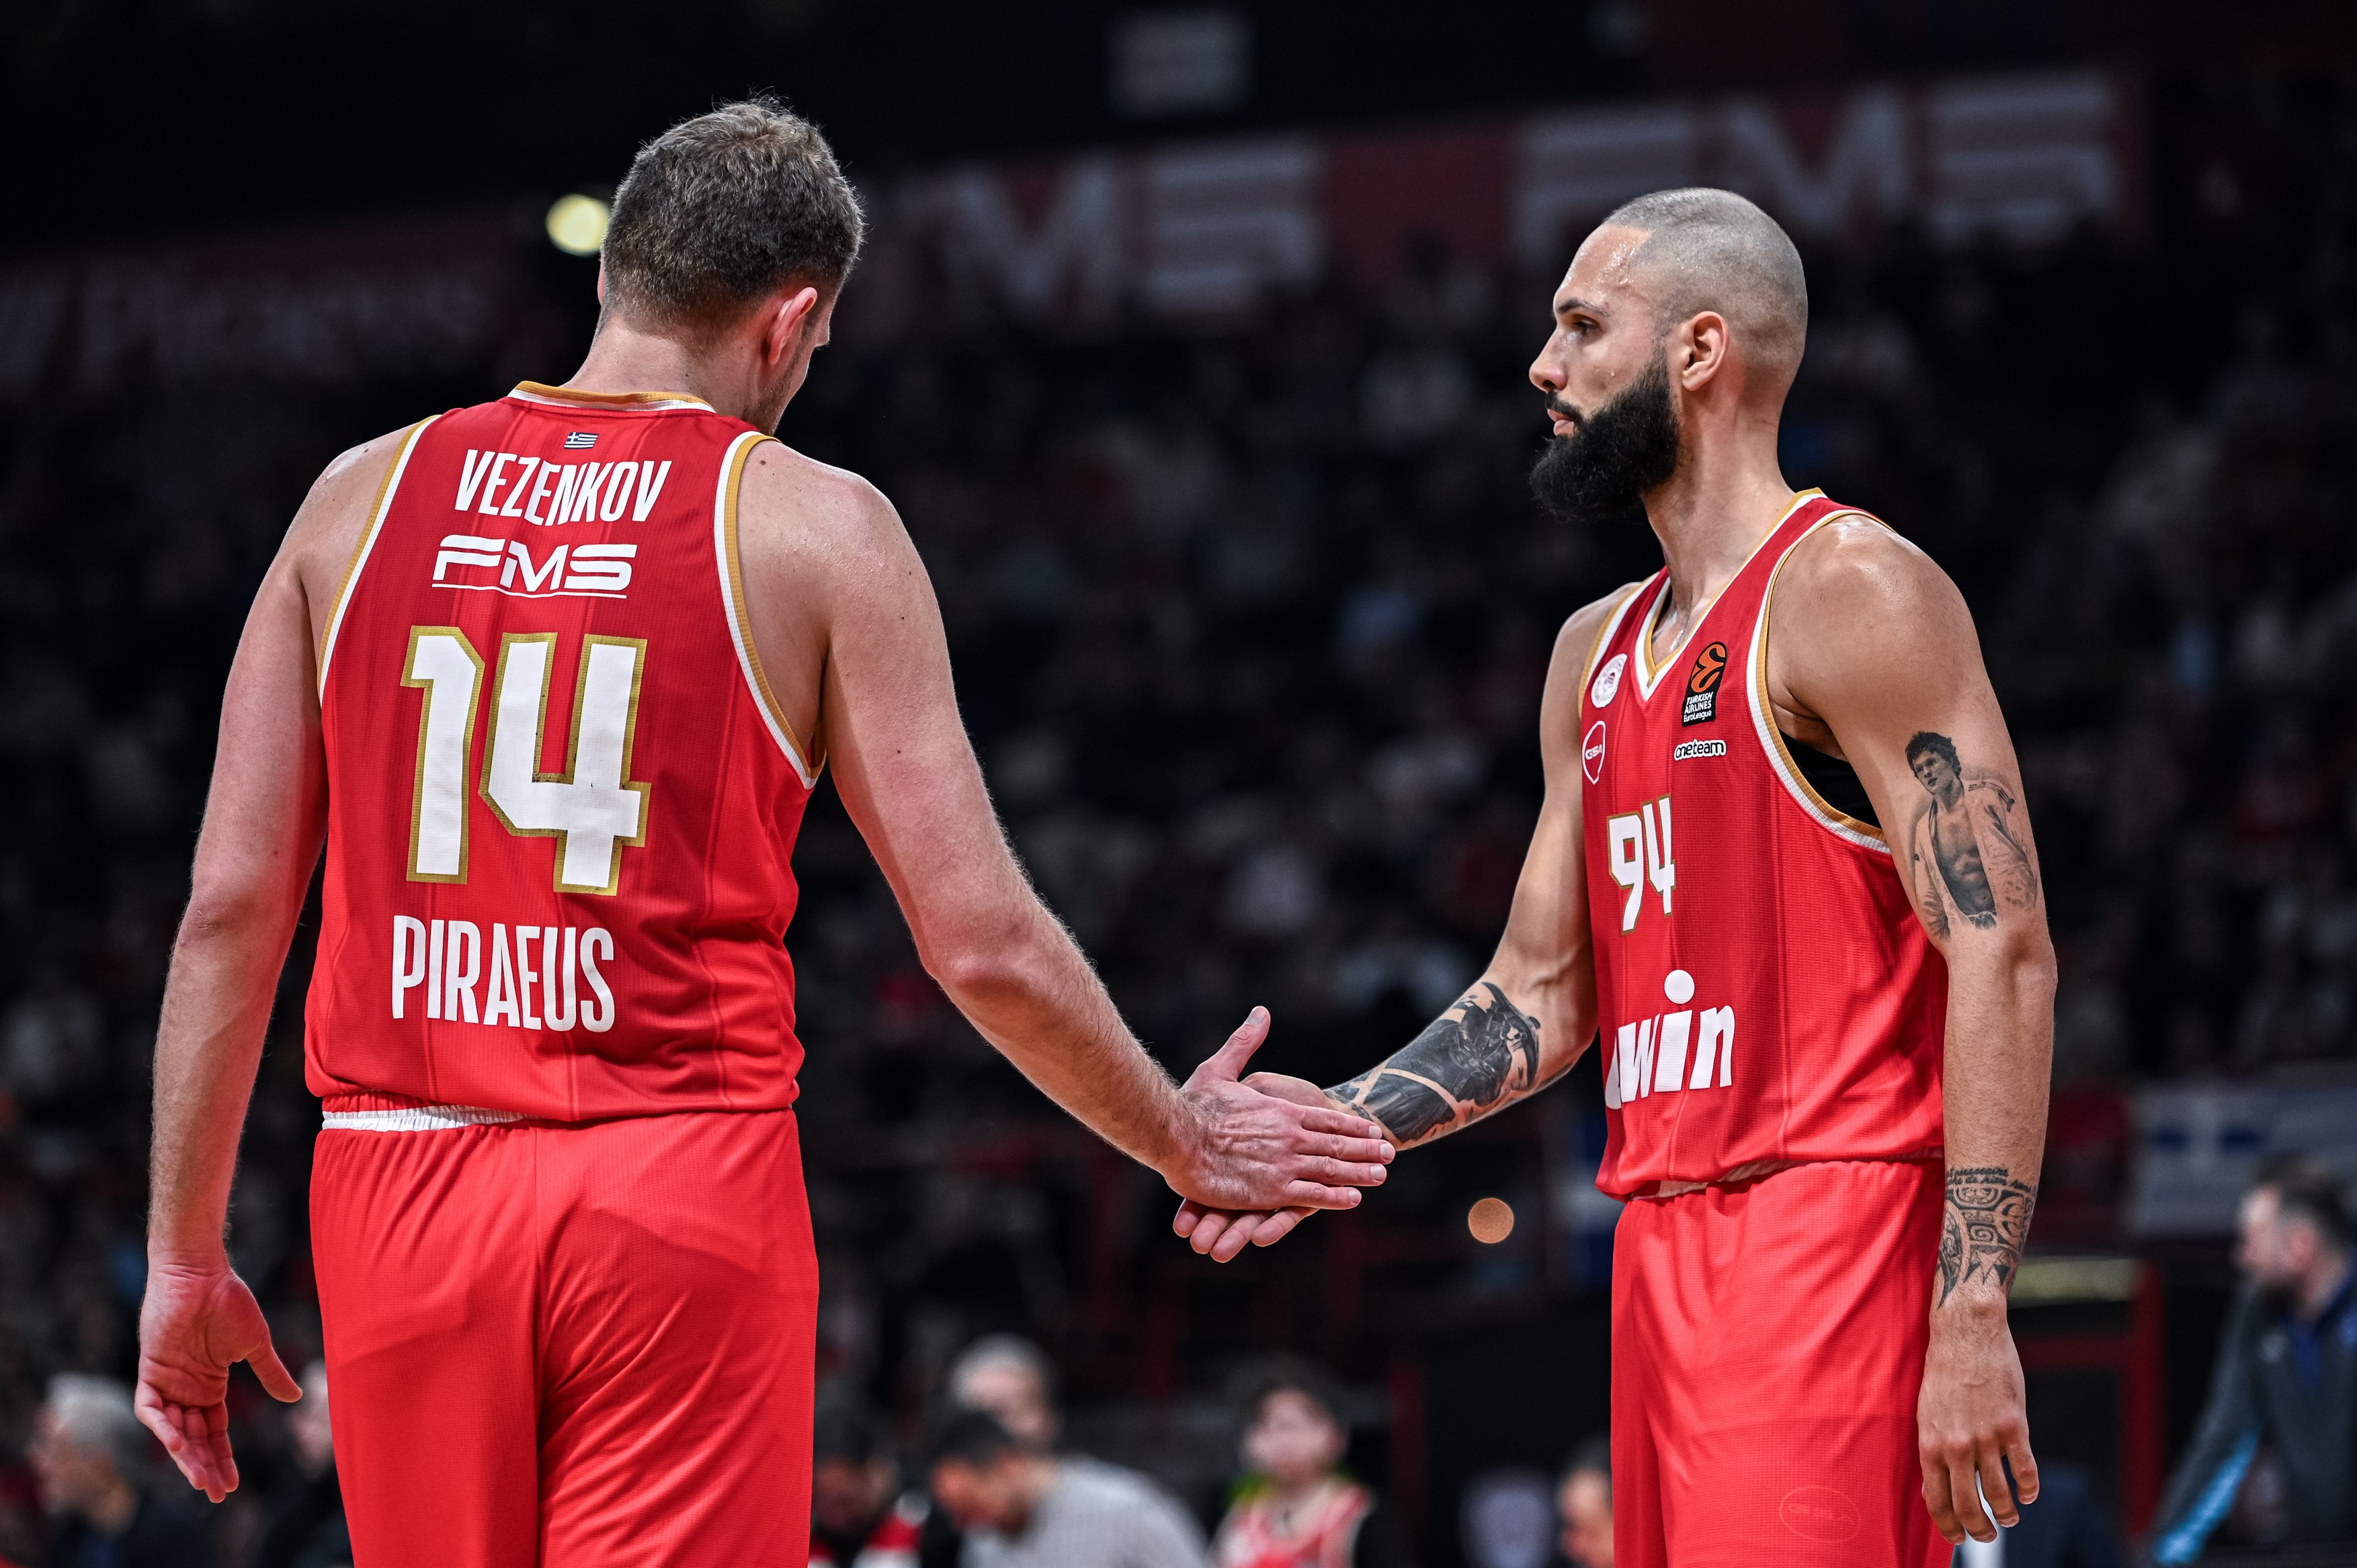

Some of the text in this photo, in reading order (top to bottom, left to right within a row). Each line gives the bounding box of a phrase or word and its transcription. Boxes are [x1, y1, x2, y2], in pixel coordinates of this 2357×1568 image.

[454, 448, 673, 527] VEZENKOV
[433, 534, 638, 593] FMS
[1684, 700, 1712, 714] AIRLINES
[1684, 710, 1712, 723] EuroLeague
[1686, 692, 1713, 705] TURKISH
[400, 625, 651, 897] 14
[1676, 741, 1725, 759] oneteam
[1607, 792, 1676, 935] 94
[392, 915, 616, 1033] PIRAEUS
